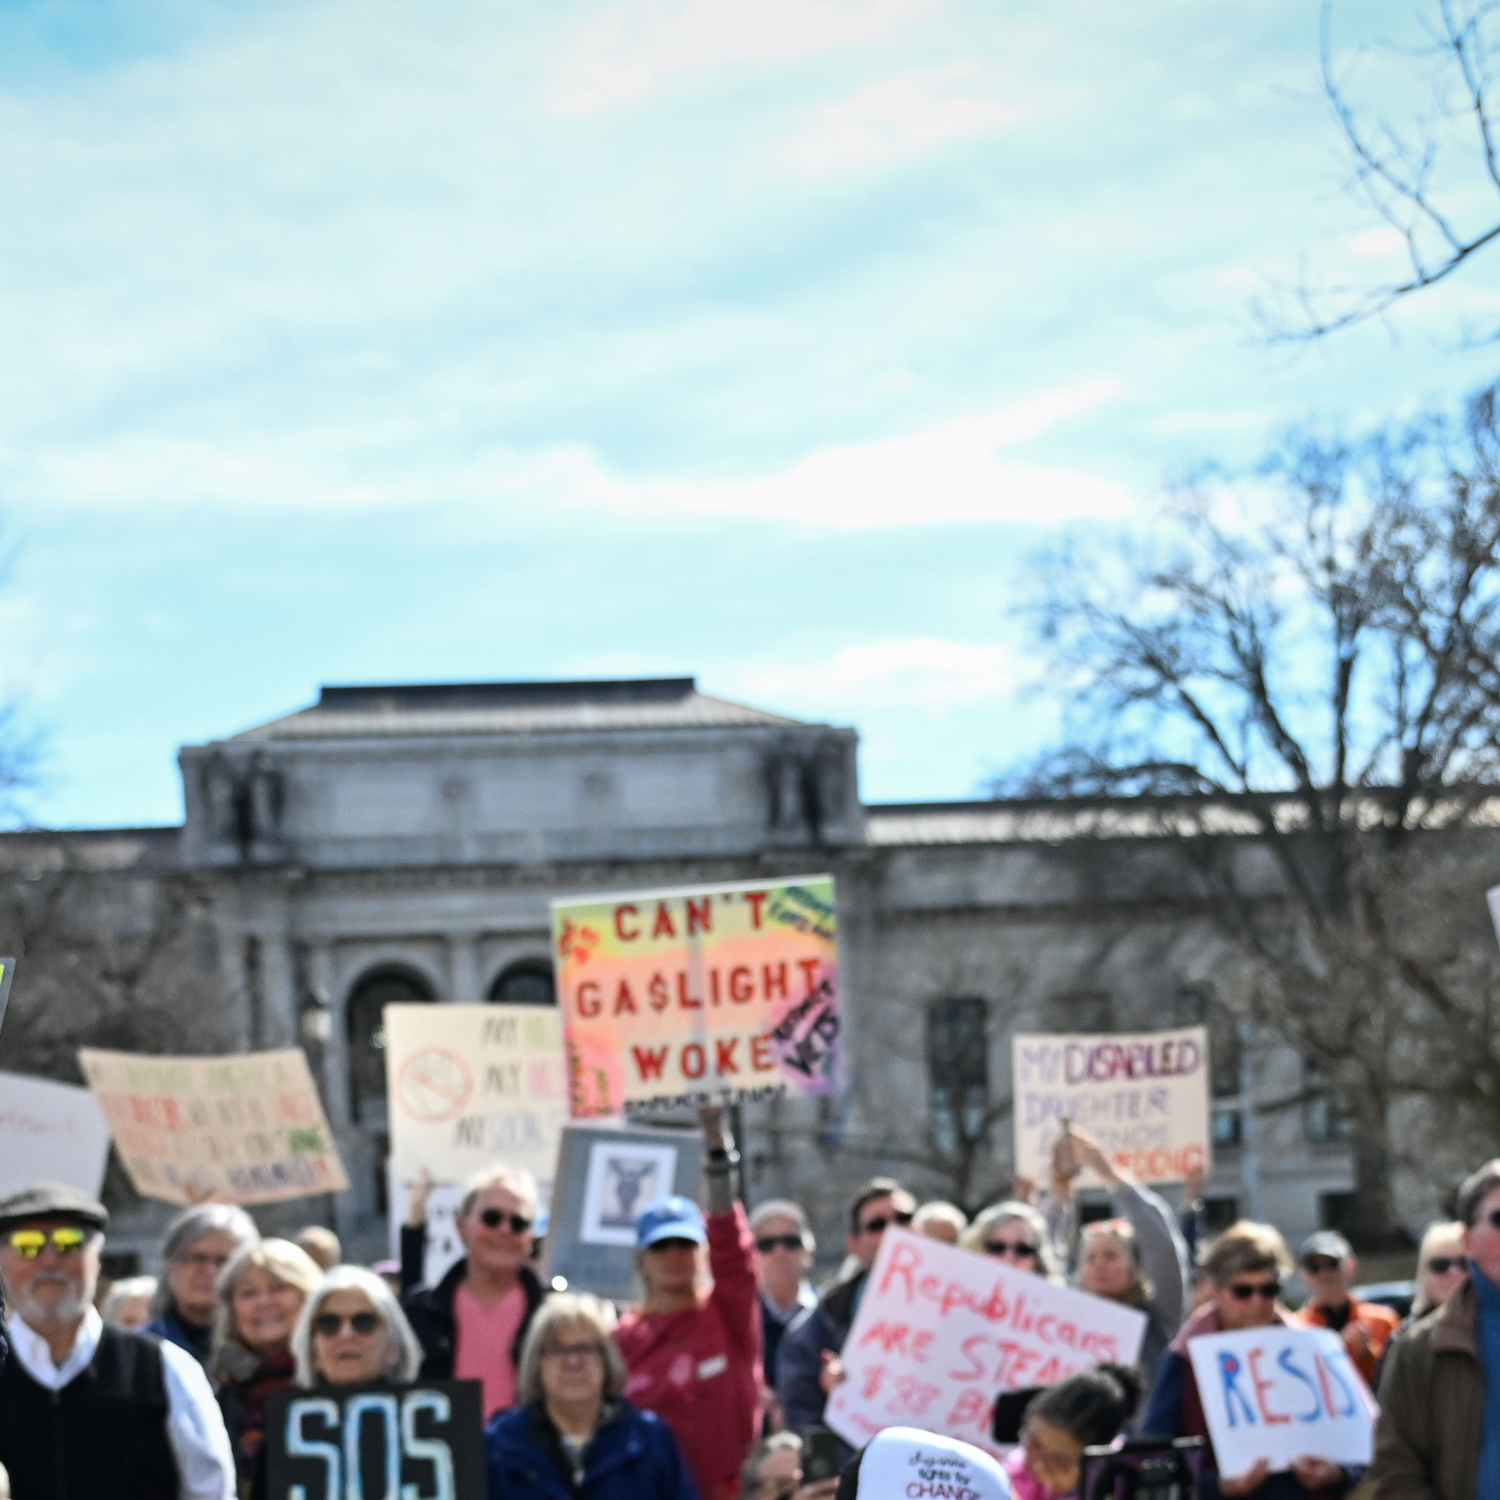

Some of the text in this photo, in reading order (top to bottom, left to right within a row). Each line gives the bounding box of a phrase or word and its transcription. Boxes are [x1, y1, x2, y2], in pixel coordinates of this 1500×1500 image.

[614, 891, 769, 941] CAN'T
[577, 958, 819, 1018] GA$LIGHT
[631, 1033, 775, 1082] WOKE
[1064, 1039, 1199, 1085] DISABLED
[879, 1240, 1119, 1363] Republicans
[859, 1319, 935, 1363] ARE
